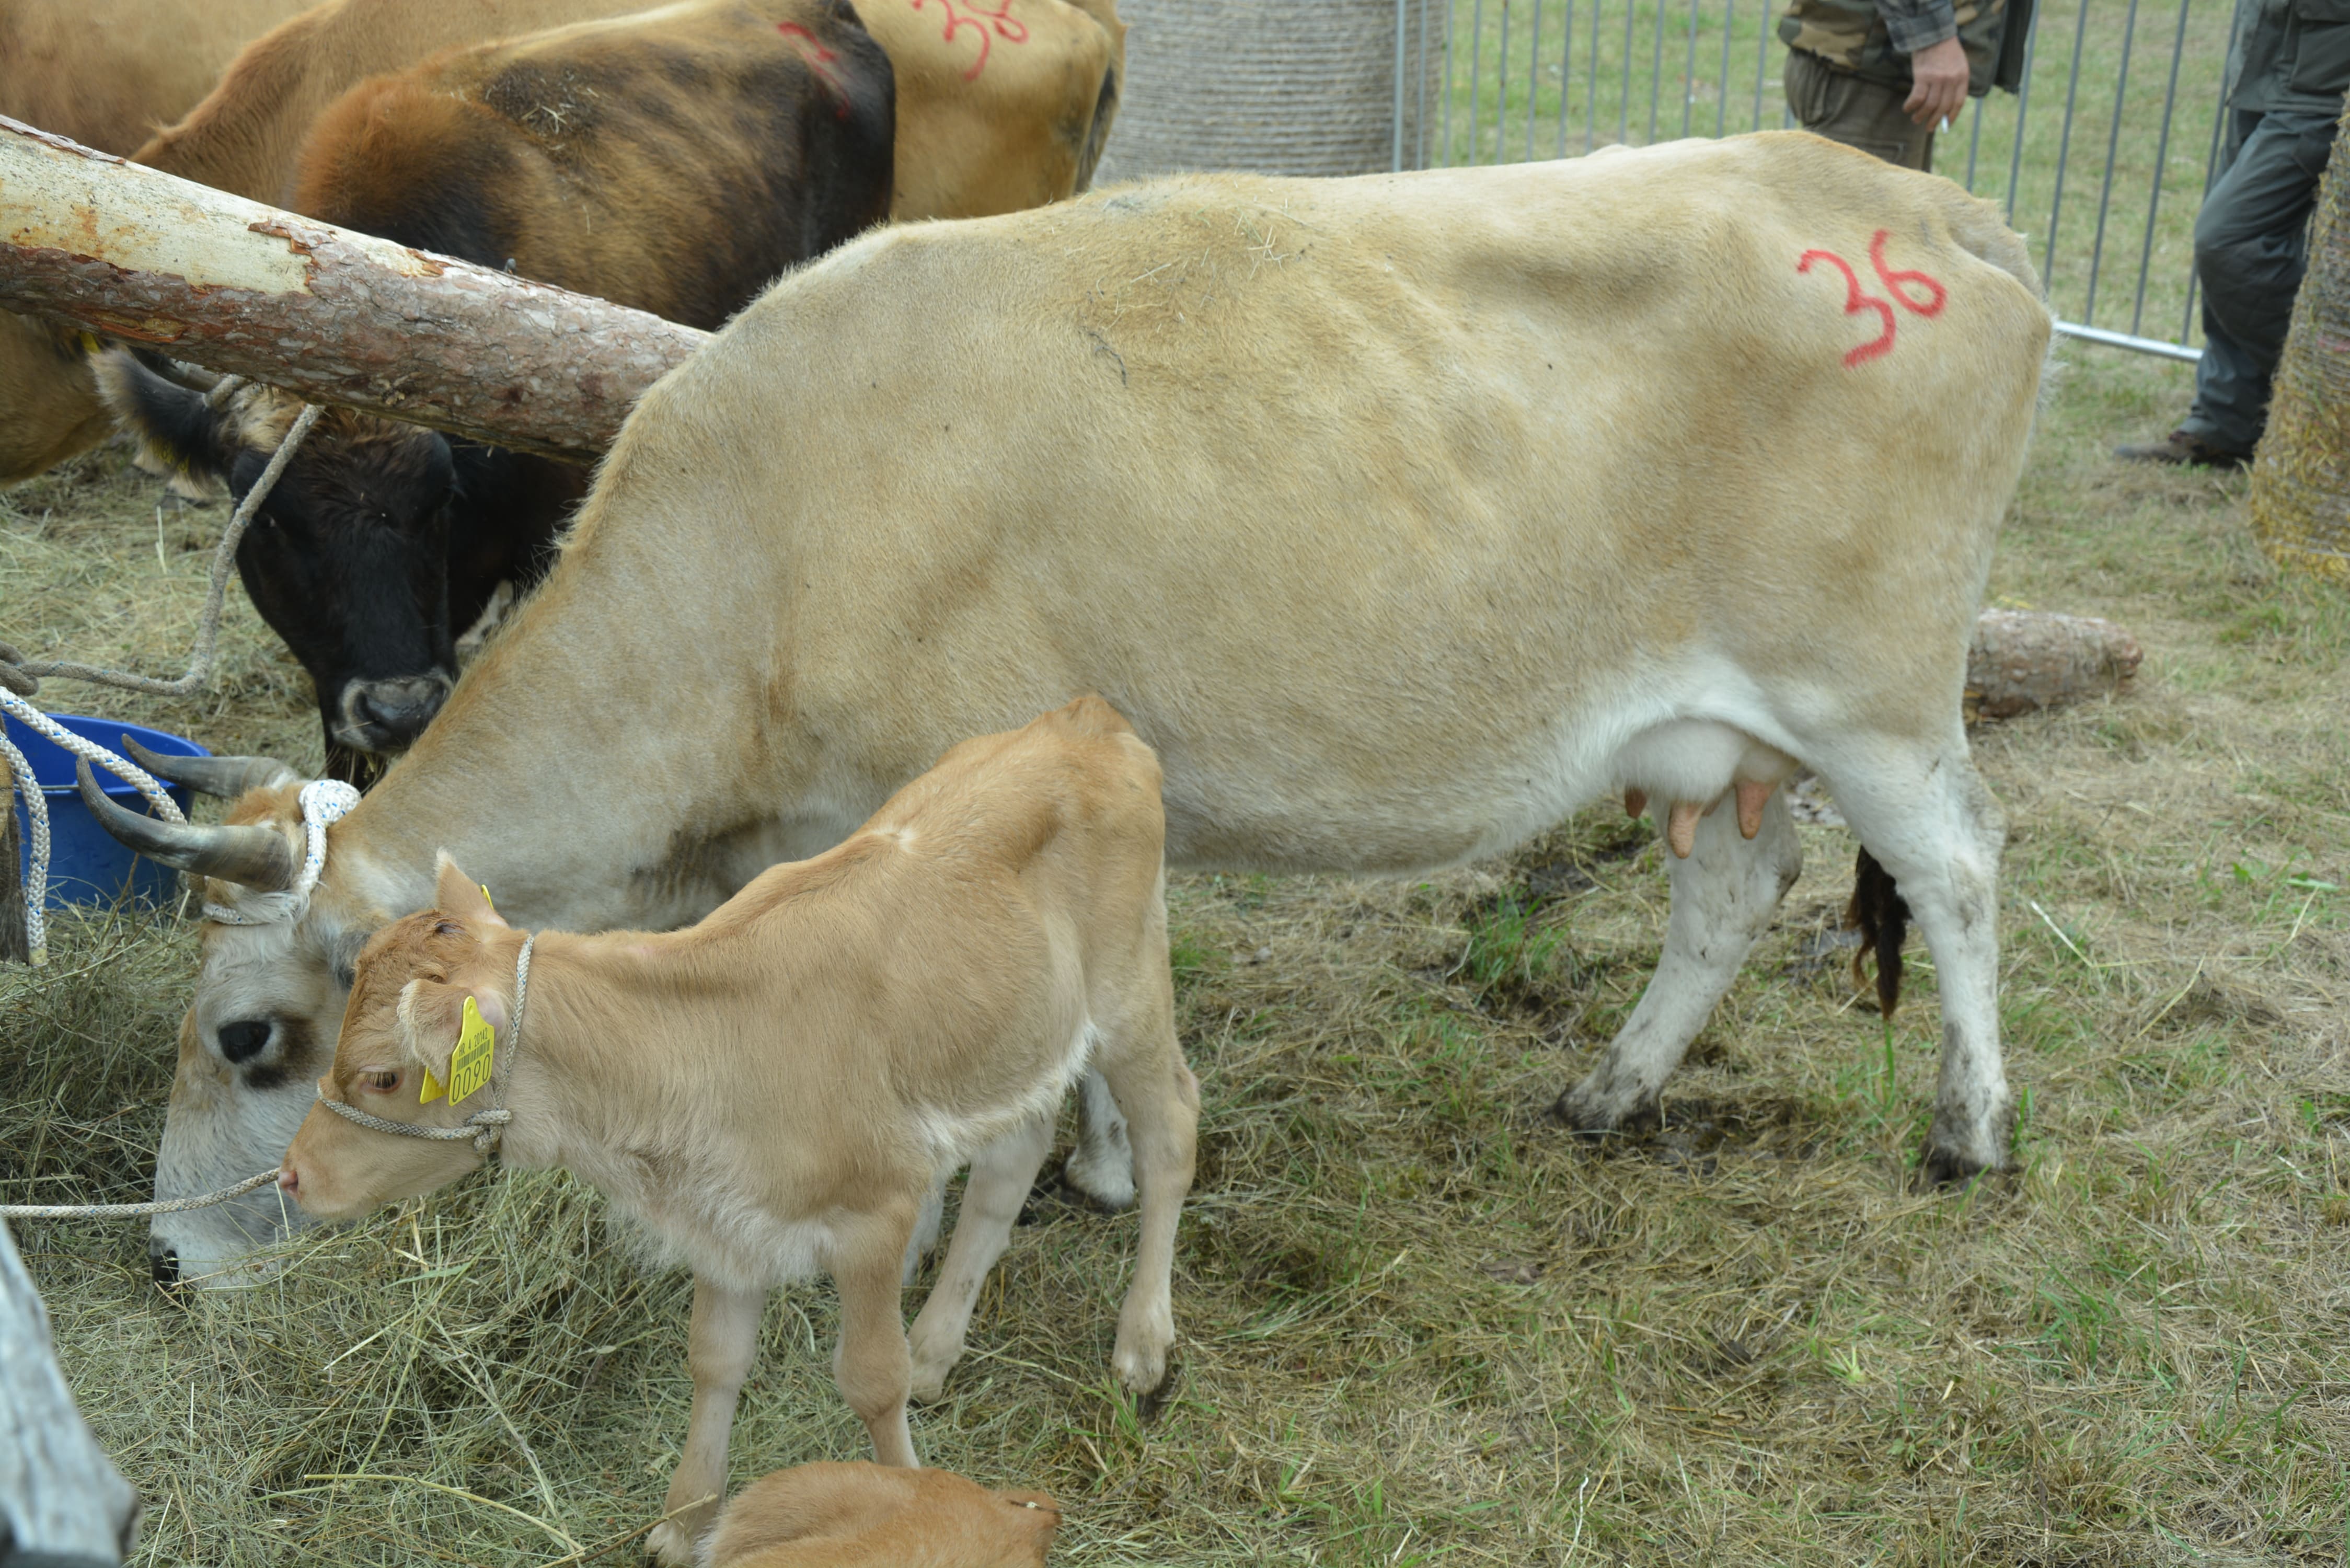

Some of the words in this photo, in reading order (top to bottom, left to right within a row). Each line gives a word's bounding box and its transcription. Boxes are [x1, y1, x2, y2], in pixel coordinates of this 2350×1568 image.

[1796, 228, 1948, 369] 36
[458, 1042, 465, 1057] HR
[452, 1053, 490, 1103] 0090
